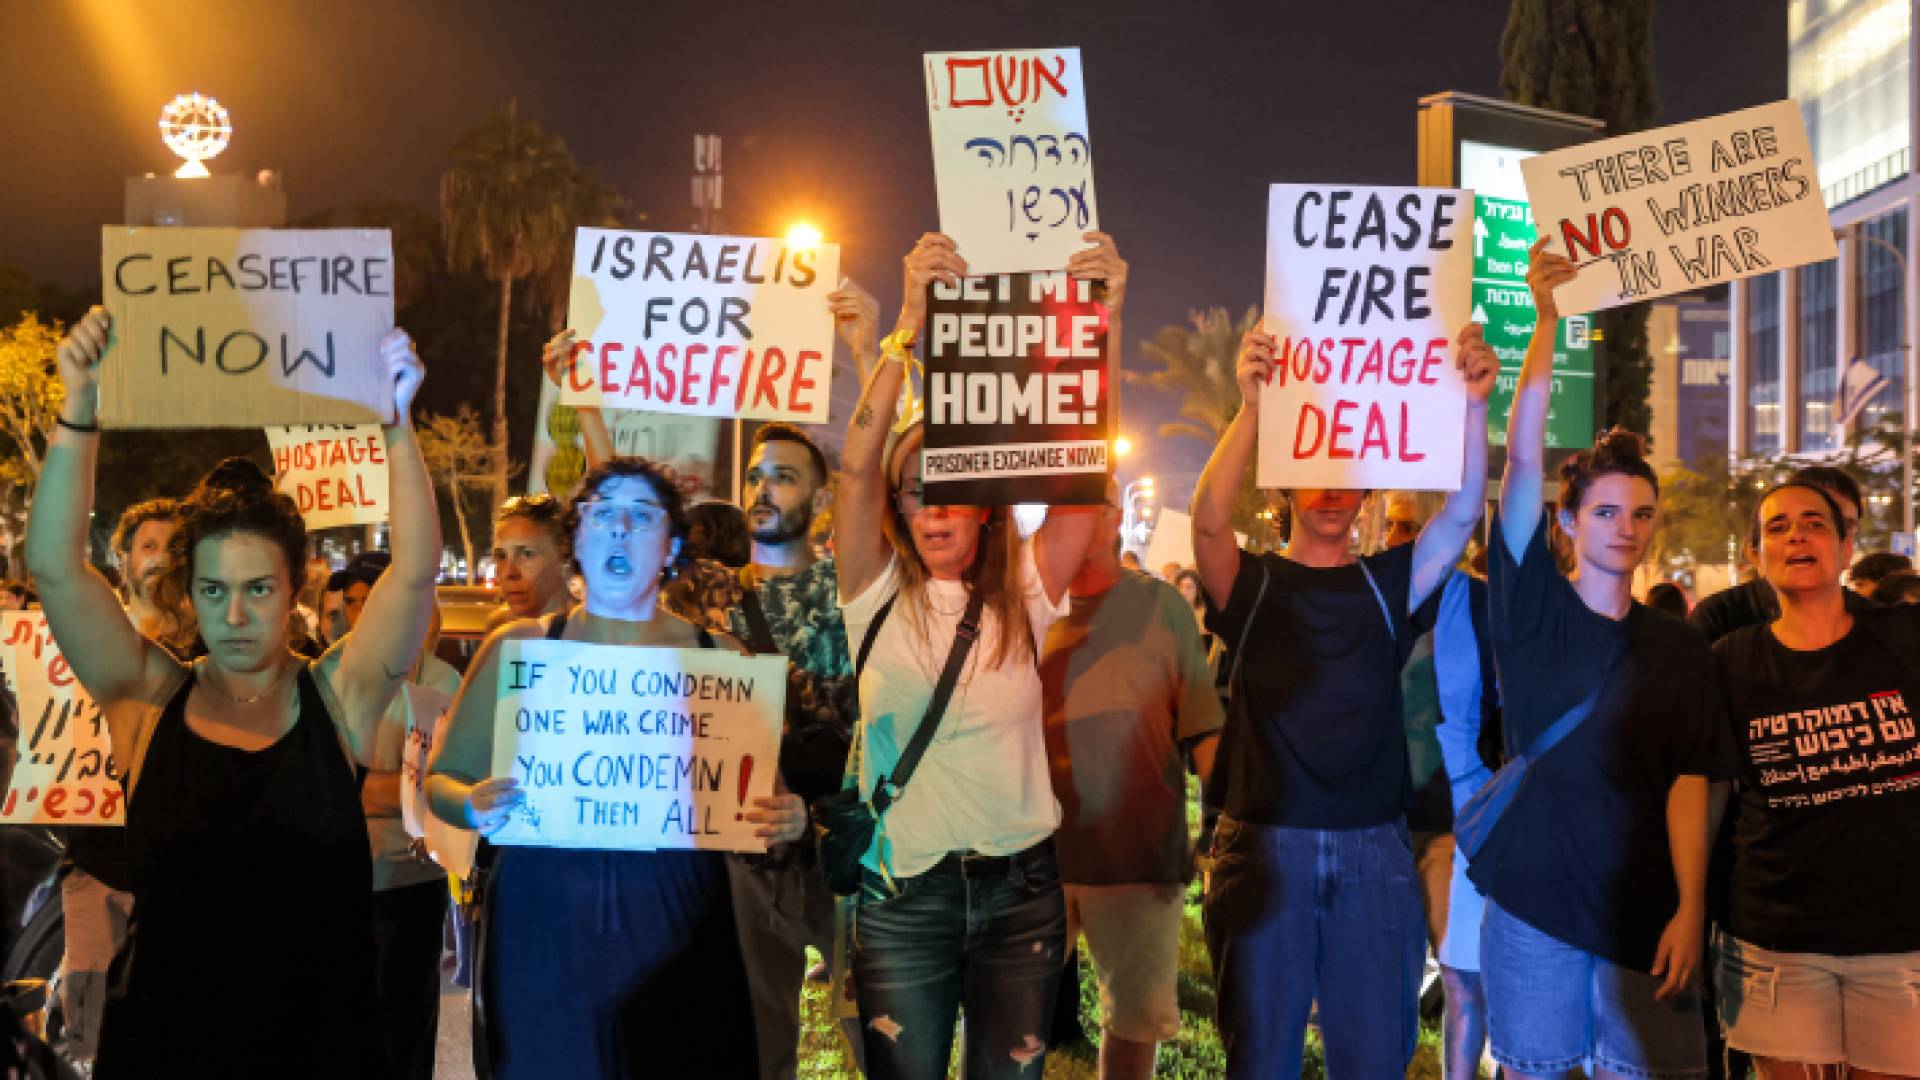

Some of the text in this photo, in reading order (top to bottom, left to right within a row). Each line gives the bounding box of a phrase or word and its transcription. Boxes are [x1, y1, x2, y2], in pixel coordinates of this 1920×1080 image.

[964, 132, 1089, 173] הדחה
[1559, 126, 1778, 201] THERE ARE
[1294, 191, 1456, 251] CEASE
[1560, 159, 1810, 261] NO WINNERS
[115, 253, 391, 296] CEASEFIRE
[591, 235, 817, 288] ISRAELIS
[1612, 227, 1771, 299] IN WAR
[1313, 264, 1431, 325] FIRE
[643, 297, 753, 340] FOR
[931, 315, 1099, 357] PEOPLE
[161, 326, 335, 378] NOW
[1265, 335, 1448, 387] HOSTAGE
[569, 340, 822, 413] CEASEFIRE
[931, 369, 1099, 425] HOME!
[1293, 399, 1425, 462] DEAL
[276, 436, 385, 472] HOSTAGE
[926, 446, 1105, 476] PRISONER EXCHANGE NOW!
[296, 474, 377, 514] DEAL
[508, 661, 754, 702] IF YOU CONDEMN
[516, 708, 565, 734] ONE
[583, 710, 629, 735] WAR
[1750, 695, 1908, 740] אין דמוקרטיה
[1796, 717, 1915, 757] עם כיבוש
[573, 751, 724, 793] CONDEMN
[2, 786, 123, 819] עכשיו
[575, 797, 638, 827] THEM
[661, 799, 720, 835] ALL
